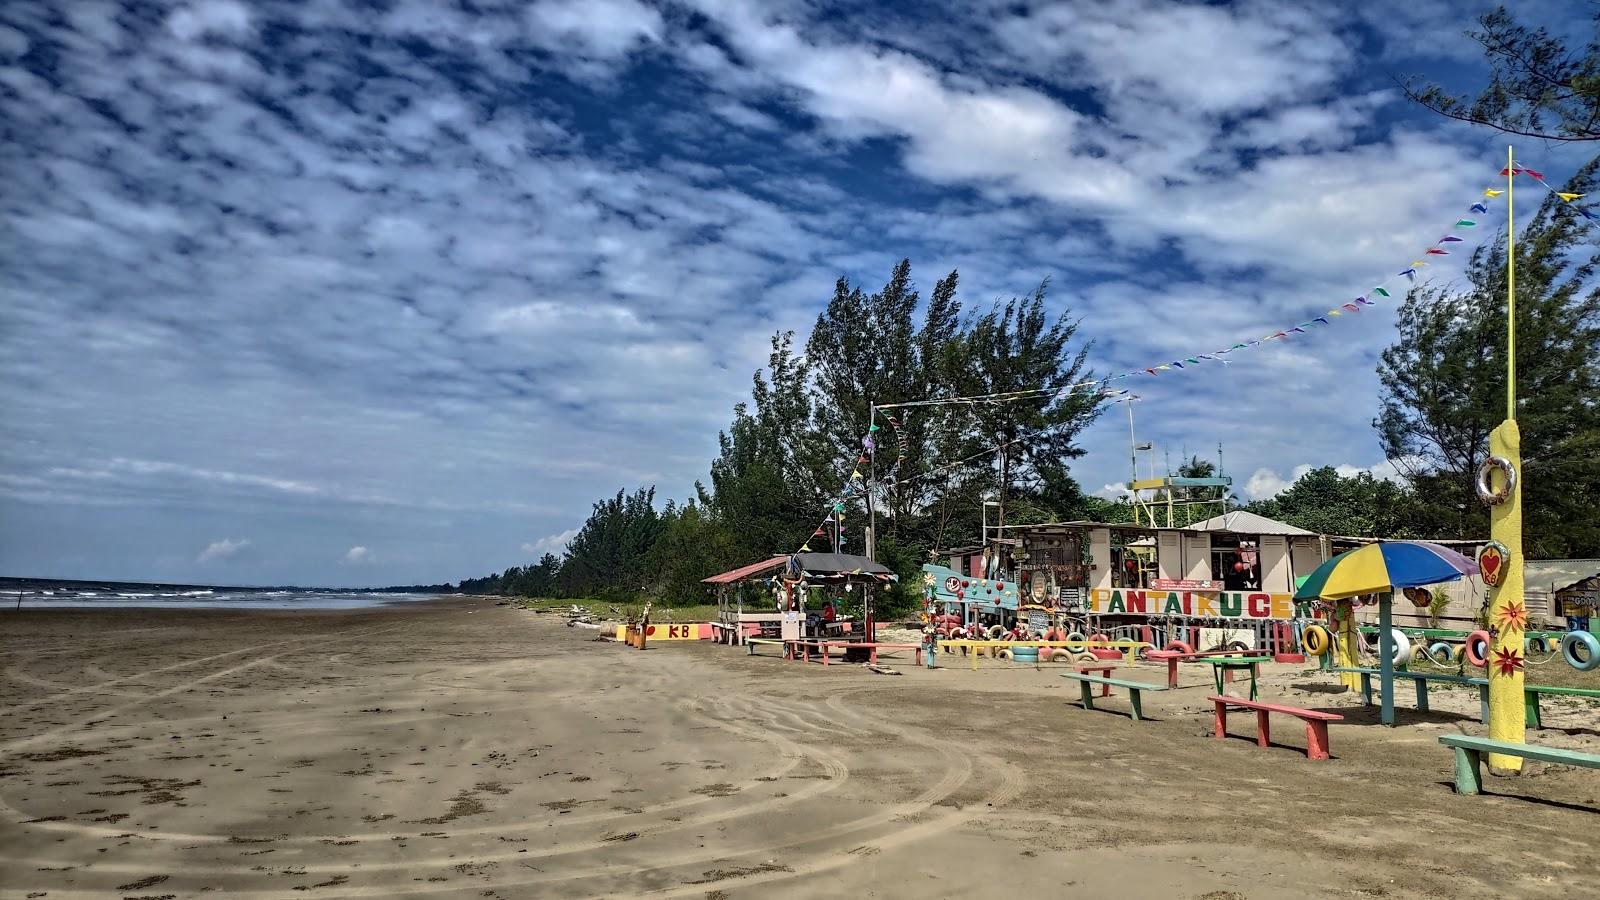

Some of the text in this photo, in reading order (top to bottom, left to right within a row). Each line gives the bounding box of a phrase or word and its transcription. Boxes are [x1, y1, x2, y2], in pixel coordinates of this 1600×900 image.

[1485, 572, 1496, 584] KB
[1091, 589, 1191, 615] PANTAI
[669, 625, 689, 638] KB
